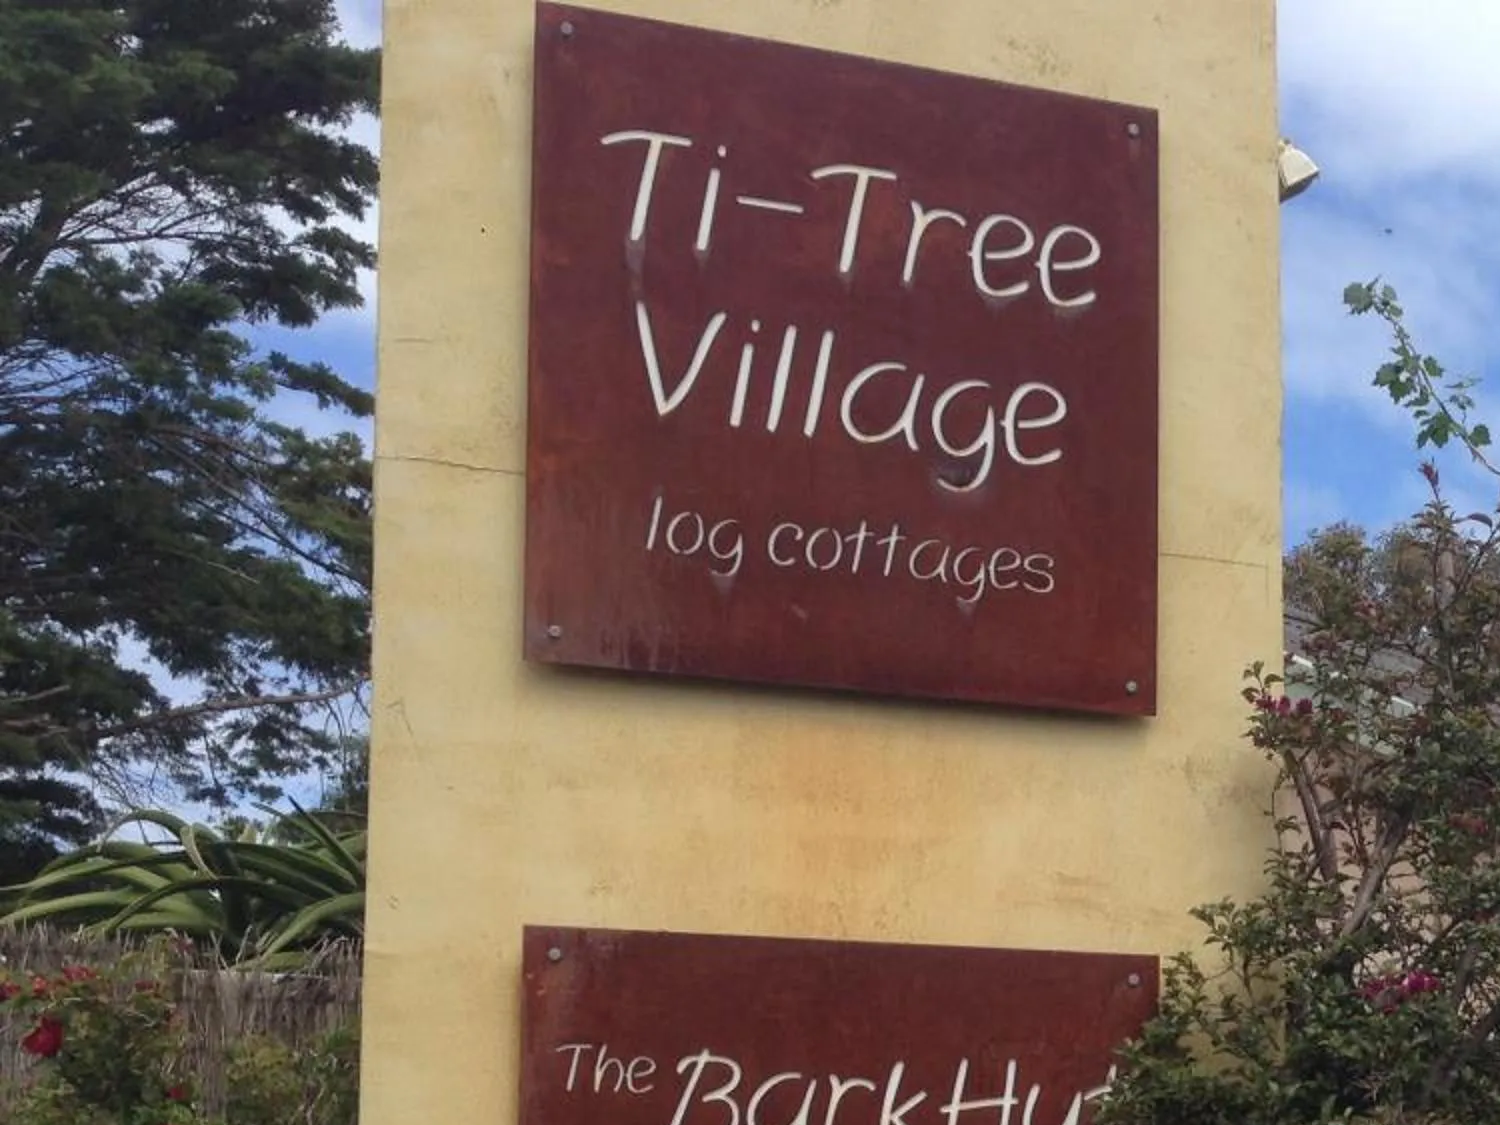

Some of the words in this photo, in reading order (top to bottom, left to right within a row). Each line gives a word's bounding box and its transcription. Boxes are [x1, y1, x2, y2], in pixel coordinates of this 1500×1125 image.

[600, 129, 1101, 308] Ti-Tree
[636, 301, 1068, 493] Village
[645, 495, 744, 578] log
[766, 520, 1055, 604] cottages
[557, 1043, 657, 1094] The
